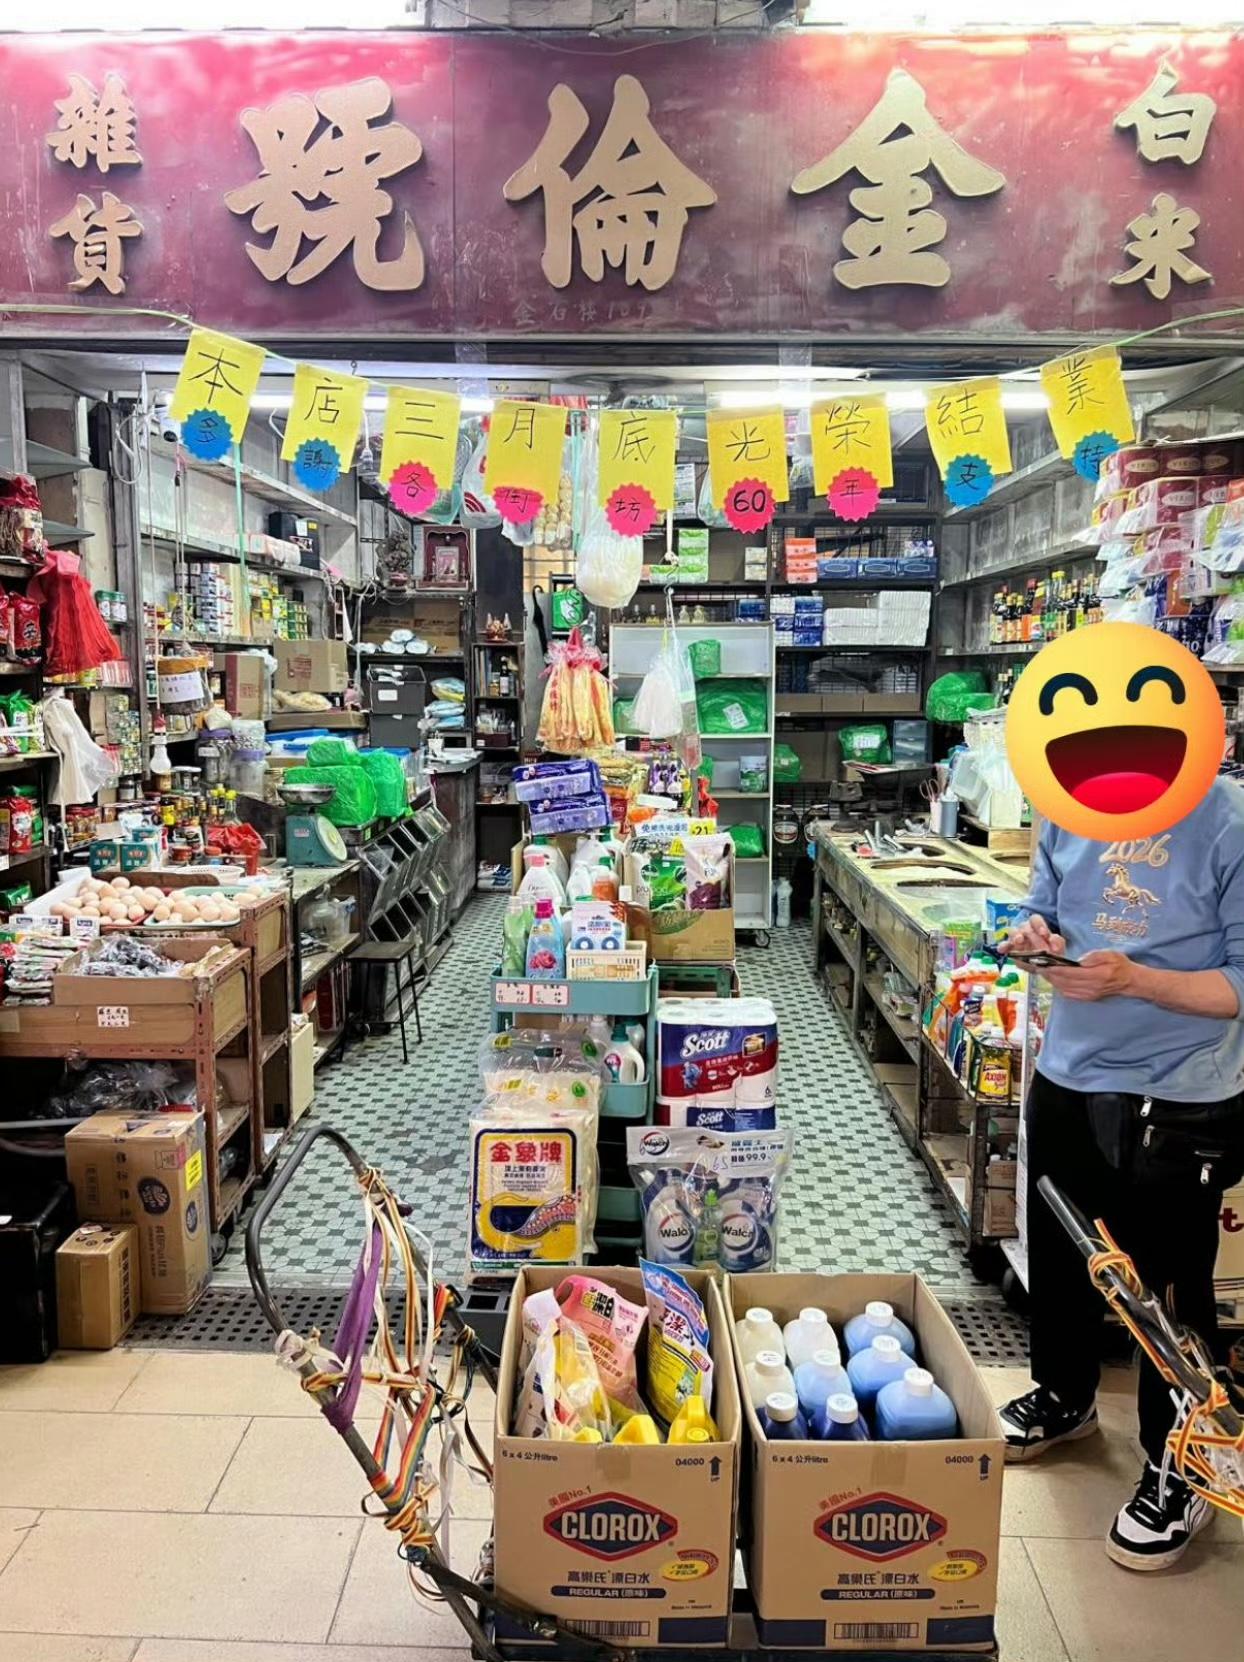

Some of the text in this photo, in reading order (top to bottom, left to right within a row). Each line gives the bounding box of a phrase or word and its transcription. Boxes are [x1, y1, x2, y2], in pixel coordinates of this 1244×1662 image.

[47, 73, 144, 296] 雜貨
[1108, 57, 1217, 300] 白米
[682, 1030, 731, 1057] Scott
[696, 1111, 723, 1126] Scott
[490, 1141, 562, 1163] 金象牌
[675, 1458, 705, 1466] 04000
[945, 1455, 974, 1464] 04000
[561, 1511, 661, 1541] CLOROX
[832, 1512, 931, 1541] CLOROX
[569, 1588, 618, 1597] REGULAR
[839, 1590, 889, 1598] REGULAR
